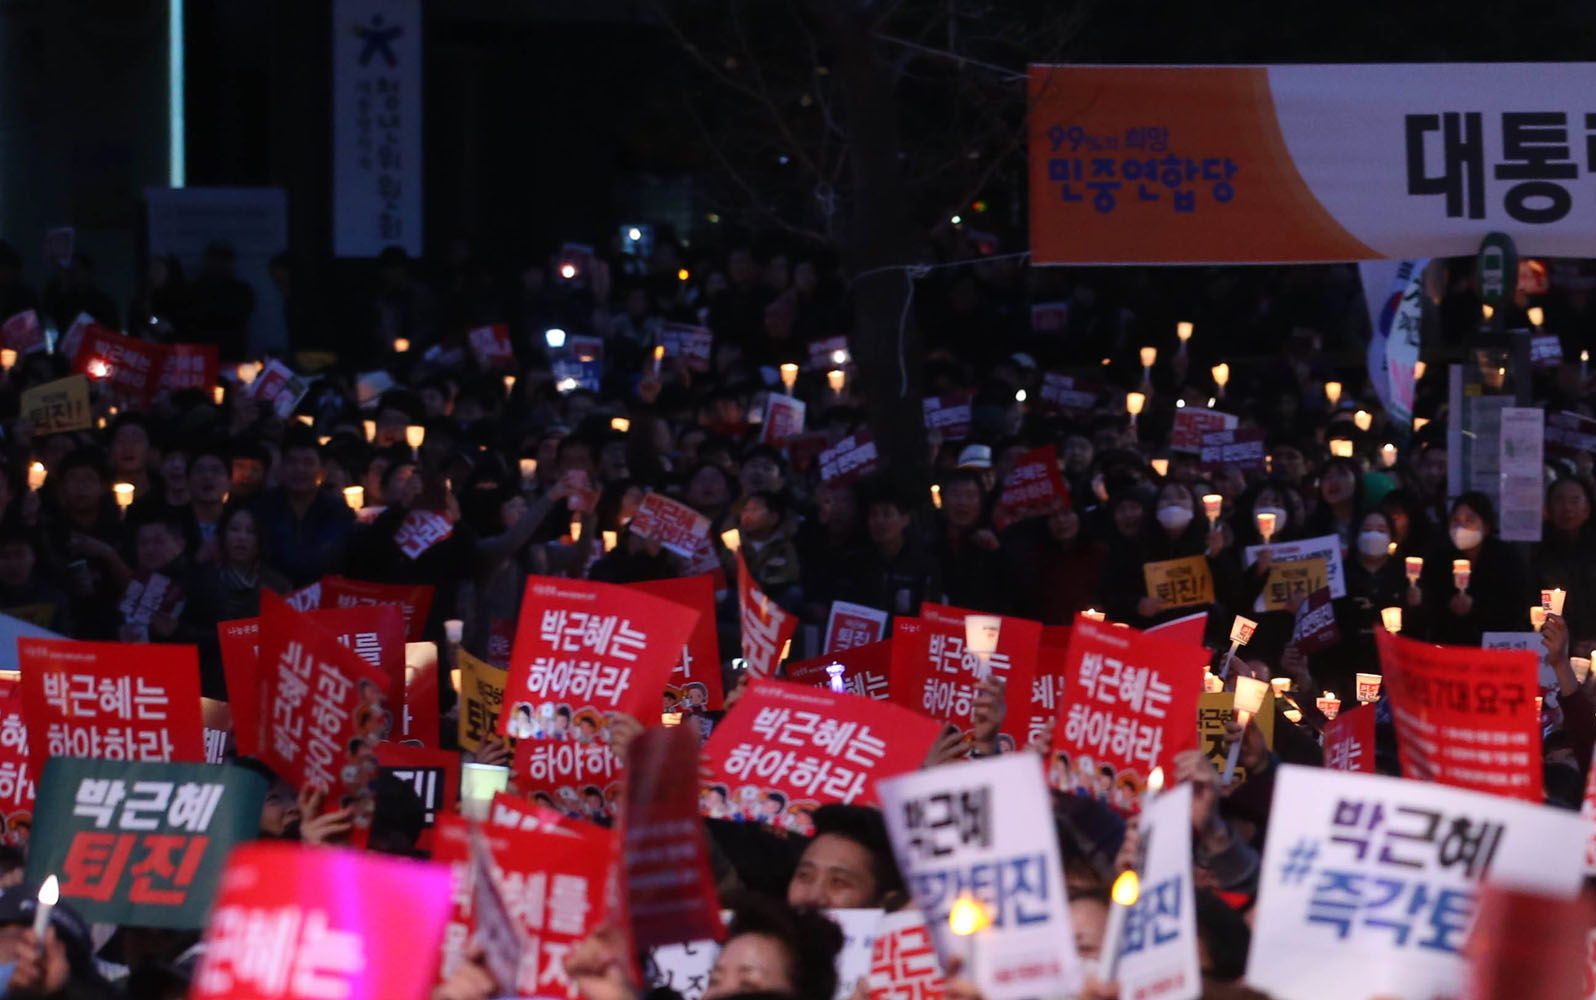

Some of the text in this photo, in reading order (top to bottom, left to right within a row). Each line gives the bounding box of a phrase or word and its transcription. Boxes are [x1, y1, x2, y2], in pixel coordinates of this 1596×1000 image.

[1047, 153, 1239, 215] 민중연합당
[1156, 573, 1206, 605] 퇴진!
[540, 608, 648, 662] 박근혜는
[42, 670, 170, 722] 박근혜는
[526, 656, 633, 707] 하야하라
[922, 677, 979, 719] 하야하
[1078, 651, 1172, 720] 박근혜는
[46, 722, 175, 763] 하야하라
[529, 744, 625, 783] 하야하
[752, 706, 887, 768] 박근혜는
[1064, 703, 1162, 768] 하야하라
[723, 743, 868, 804] 하야하라
[71, 777, 226, 833] 박근혜
[908, 785, 994, 858] 박근혜
[60, 830, 211, 906] 퇴진
[1329, 797, 1506, 881] 박근혜
[1280, 836, 1480, 956] #즉각퇴
[206, 906, 367, 1000] 근혜는
[868, 923, 937, 982] 박근
